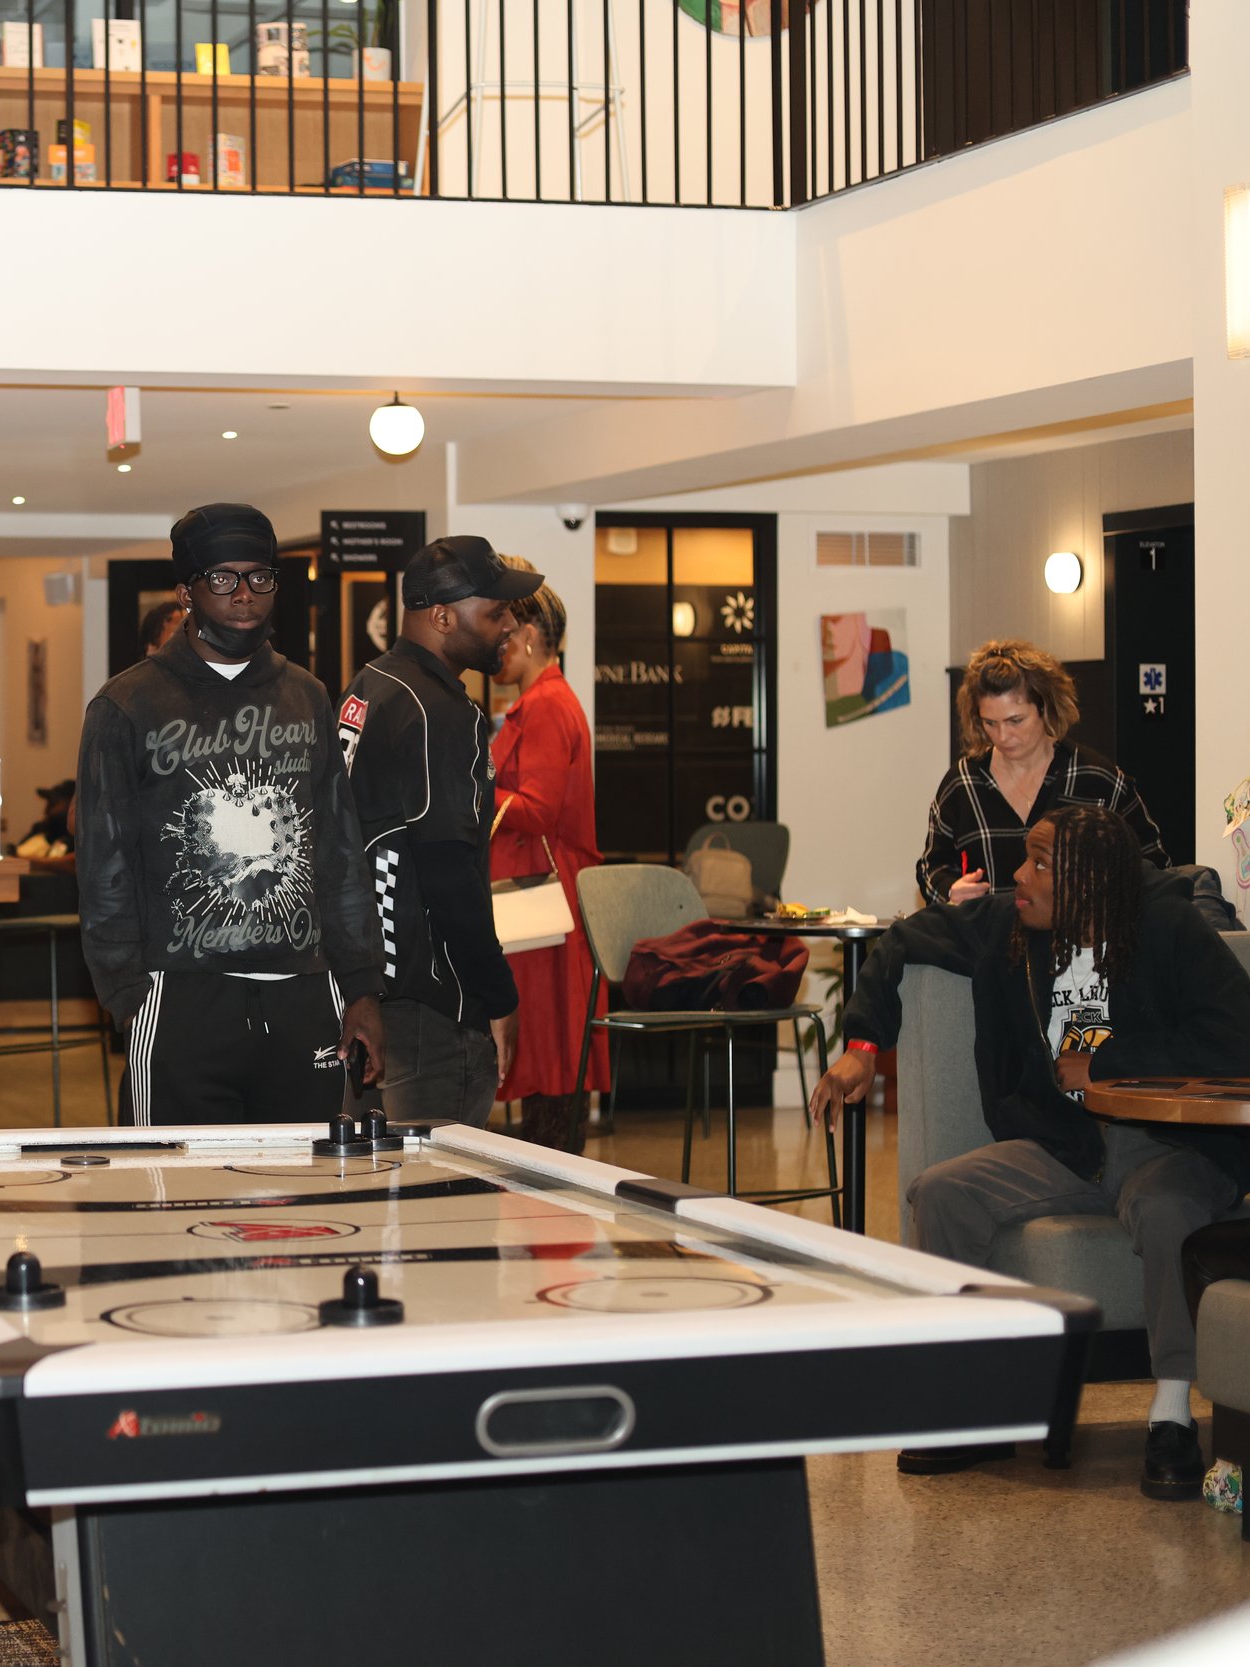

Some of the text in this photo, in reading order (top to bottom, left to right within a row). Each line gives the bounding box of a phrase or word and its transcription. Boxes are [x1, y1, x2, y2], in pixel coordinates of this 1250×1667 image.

[1150, 547, 1156, 571] 1
[1158, 697, 1164, 714] 1
[146, 719, 231, 776] Club
[167, 912, 284, 958] Members
